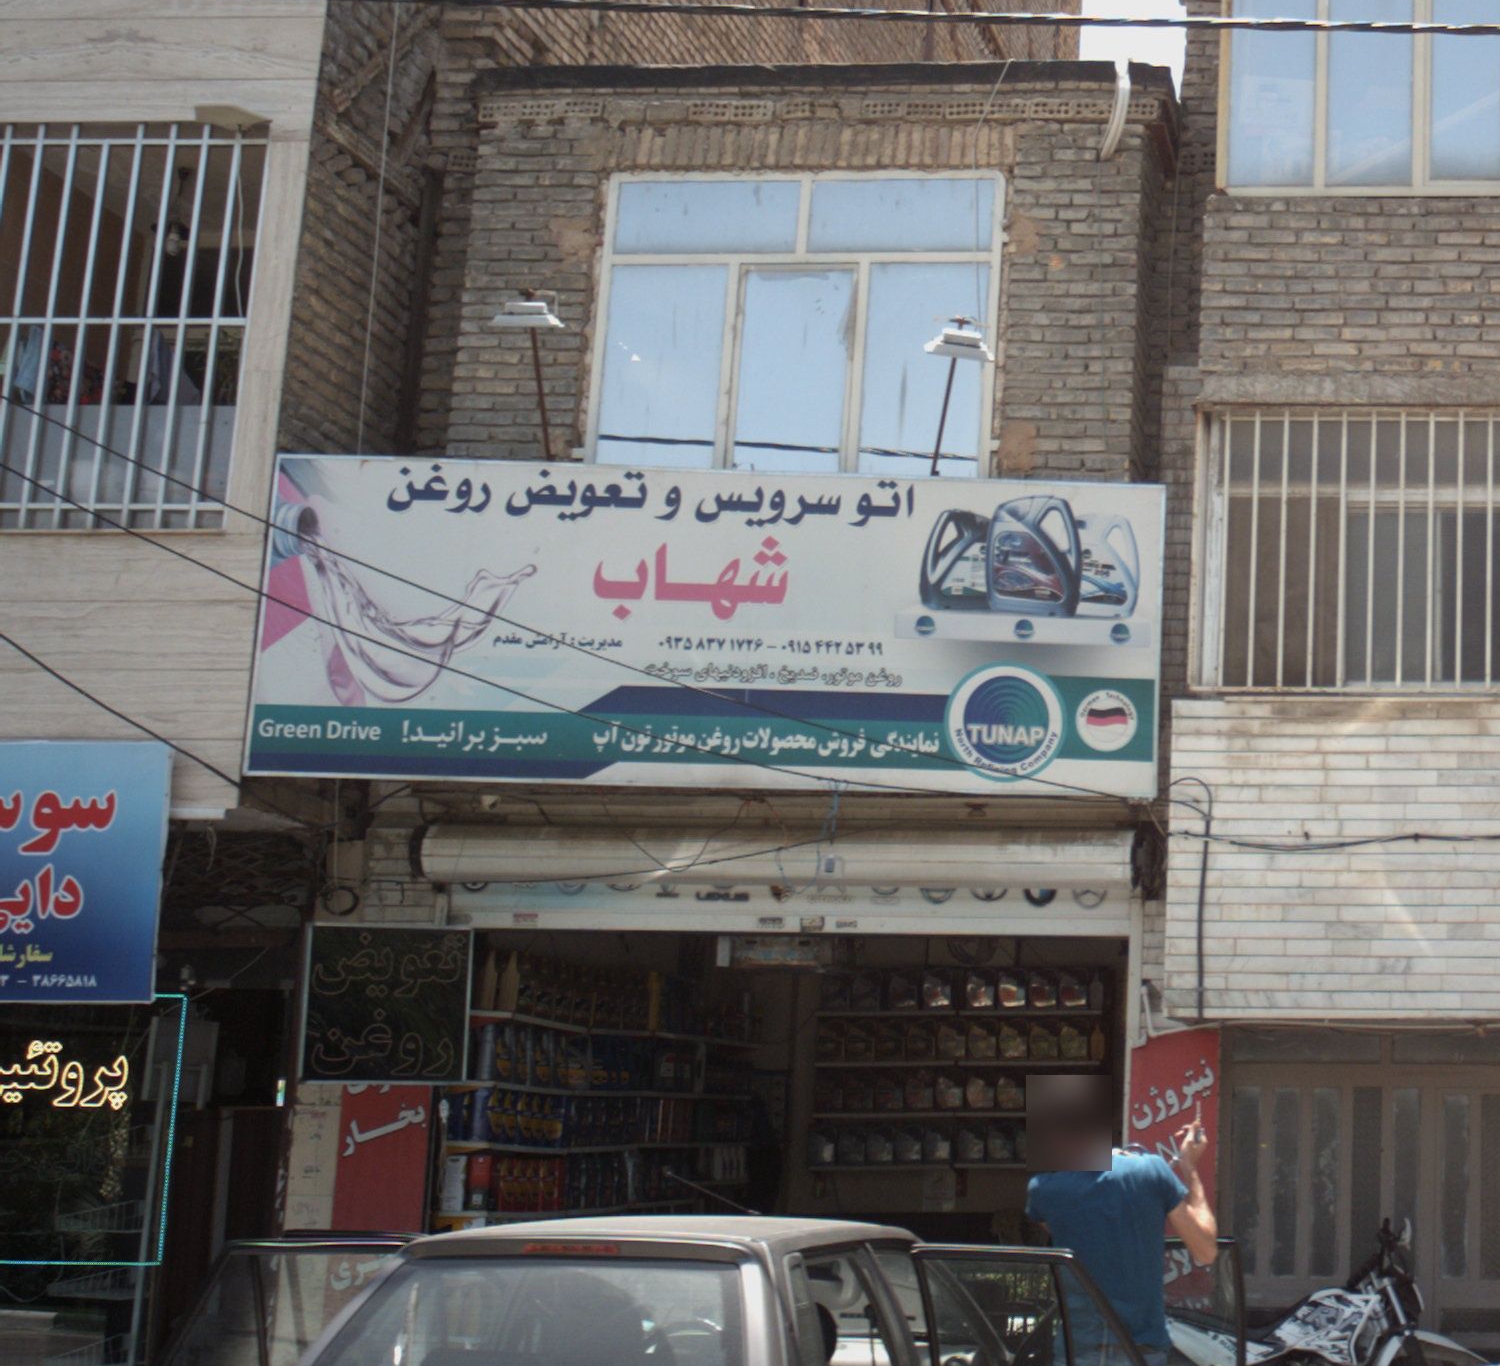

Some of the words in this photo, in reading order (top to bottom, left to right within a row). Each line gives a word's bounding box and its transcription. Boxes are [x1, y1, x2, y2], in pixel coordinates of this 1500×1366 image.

[387, 464, 491, 511] روغن
[505, 469, 648, 521] تعویض
[655, 486, 681, 520] و
[849, 480, 914, 527] اتو
[695, 485, 841, 527] سرویس
[592, 536, 788, 620] شهاب
[865, 667, 903, 687] روغن
[258, 719, 321, 739] Green
[326, 721, 381, 741] Drive
[488, 726, 548, 752] سبز
[652, 725, 696, 753] موتور
[698, 728, 741, 754] روغن
[742, 726, 817, 755] محصولات
[818, 728, 867, 757] فروش
[870, 731, 940, 759] نمایندگی
[966, 723, 1046, 747] TUNAP
[953, 727, 974, 758] North
[1020, 731, 1060, 771] Company
[312, 932, 467, 997] تعویض
[311, 1008, 454, 1075] روغن
[1131, 1058, 1215, 1130] نیتروژن
